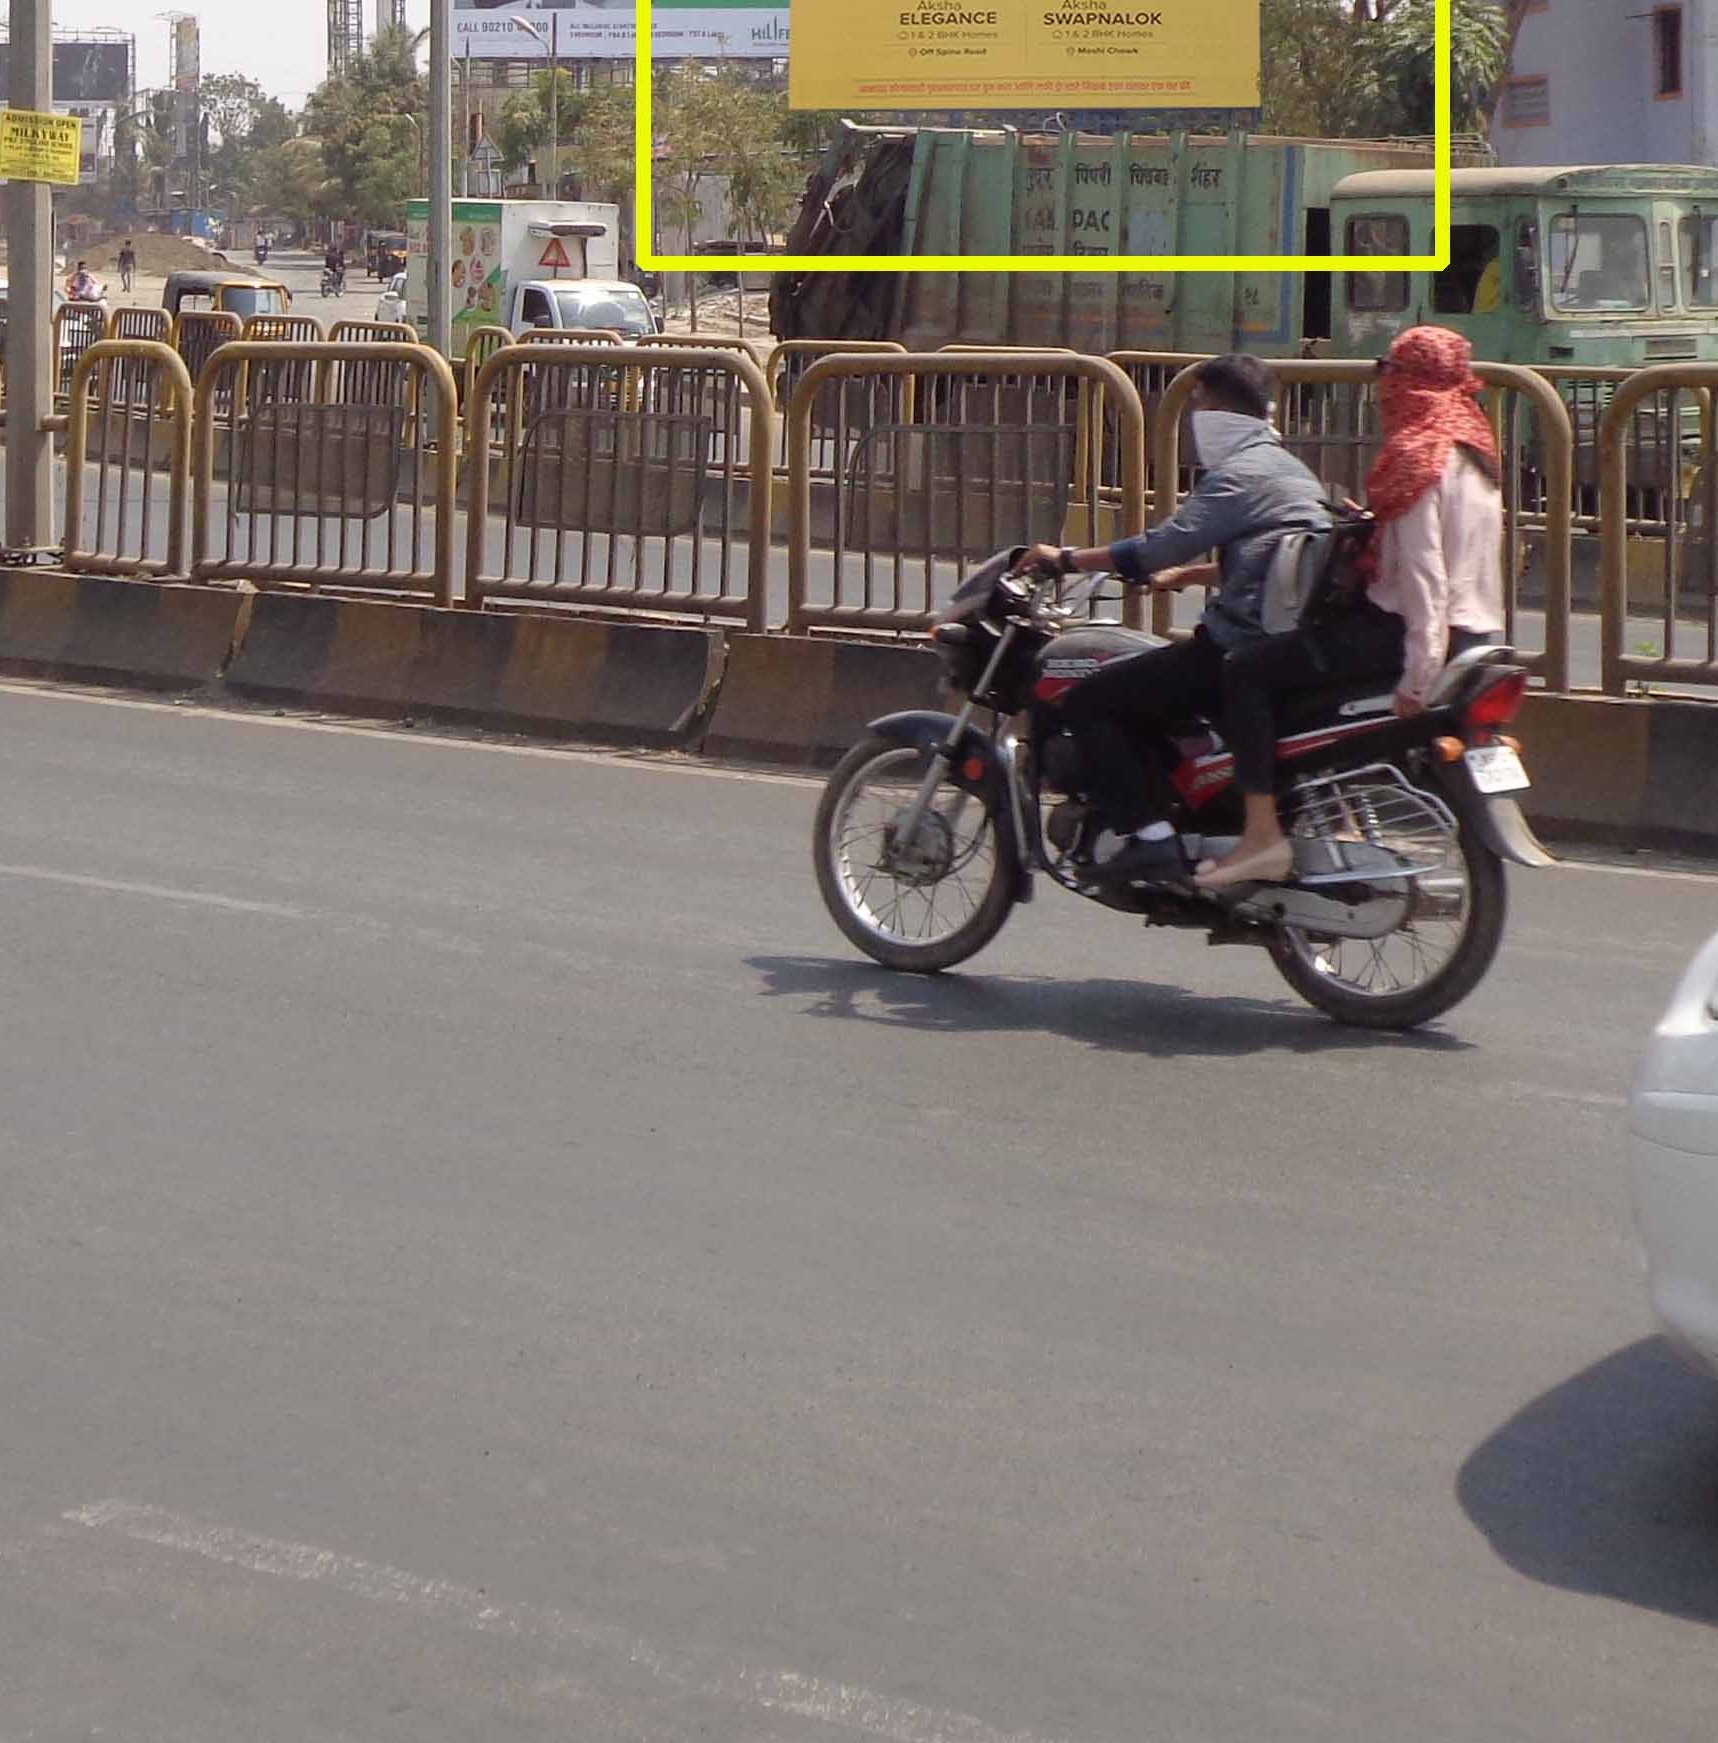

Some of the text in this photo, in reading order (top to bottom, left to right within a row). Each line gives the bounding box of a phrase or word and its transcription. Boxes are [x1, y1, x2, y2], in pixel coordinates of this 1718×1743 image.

[917, 0, 963, 11] Aksha
[1061, 0, 1107, 10] Aksha
[899, 12, 998, 25] ELEGANCE
[1043, 12, 1162, 25] SWAPNALOK
[457, 23, 479, 33] CALL
